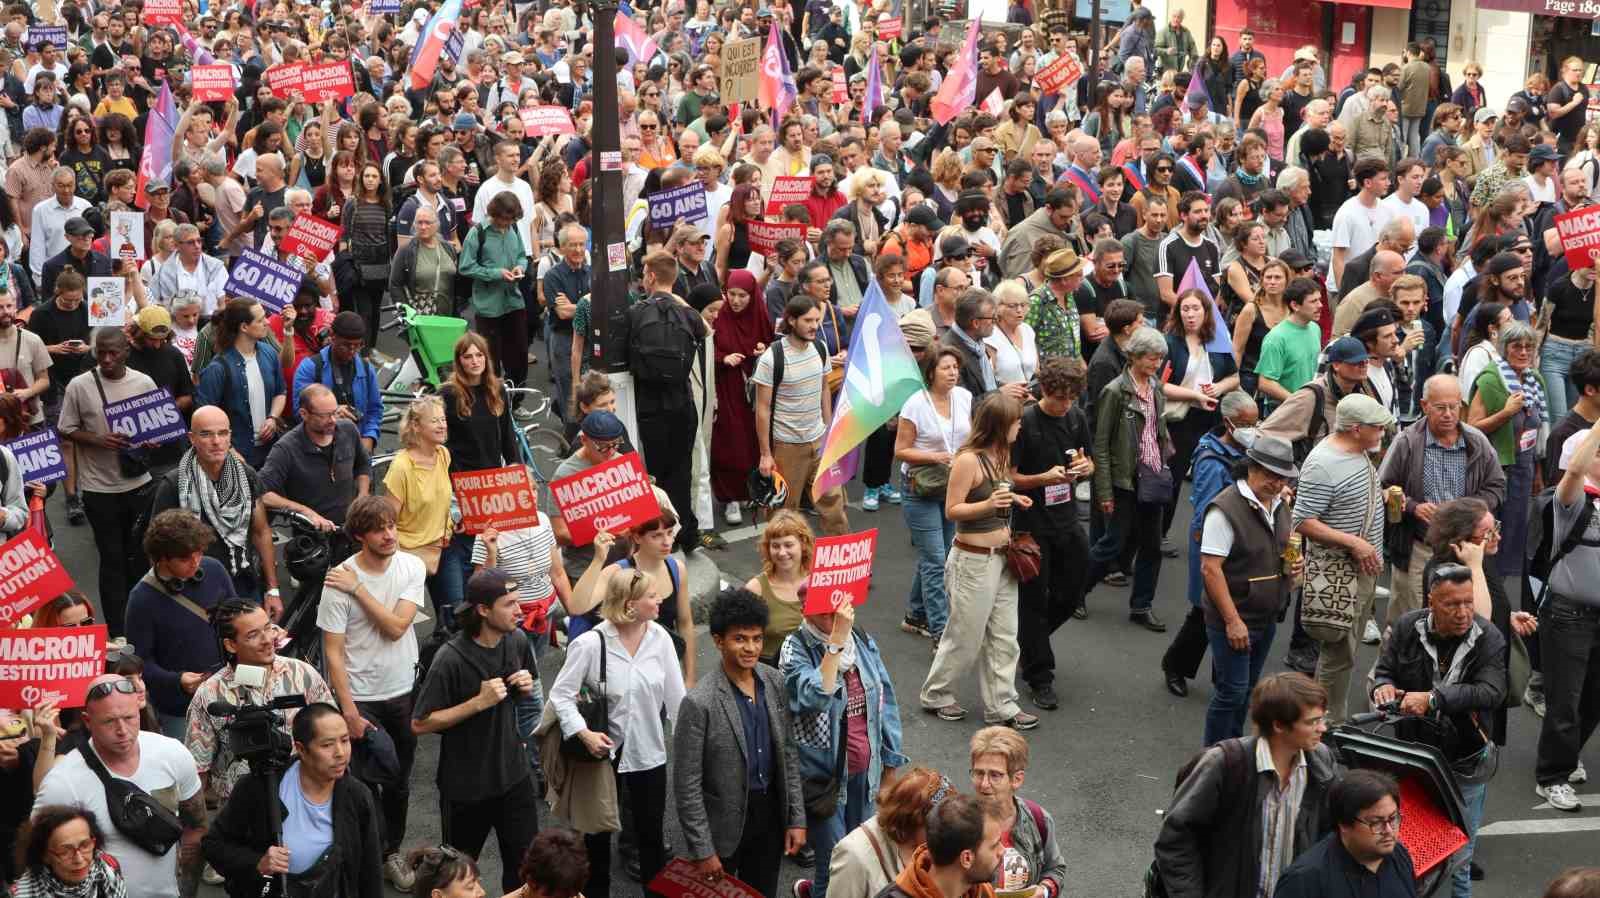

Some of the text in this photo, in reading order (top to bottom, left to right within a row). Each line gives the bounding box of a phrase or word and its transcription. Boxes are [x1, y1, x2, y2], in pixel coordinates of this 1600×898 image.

[1544, 0, 1576, 14] Page
[651, 202, 673, 219] 60
[674, 193, 705, 217] ANS
[1558, 211, 1600, 237] MAC
[242, 249, 261, 263] POUR
[260, 257, 269, 267] LA
[233, 262, 261, 286] 60
[257, 273, 297, 303] ANS
[105, 387, 171, 417] POUR LA RETRAITE À
[137, 403, 180, 433] ANS
[18, 445, 61, 474] ANS
[454, 470, 527, 491] POUR LE SMIC
[555, 461, 643, 507] MACRON,
[0, 539, 46, 578] RON,
[815, 537, 873, 569] MACRON,
[0, 661, 102, 681] ESTITUTION!
